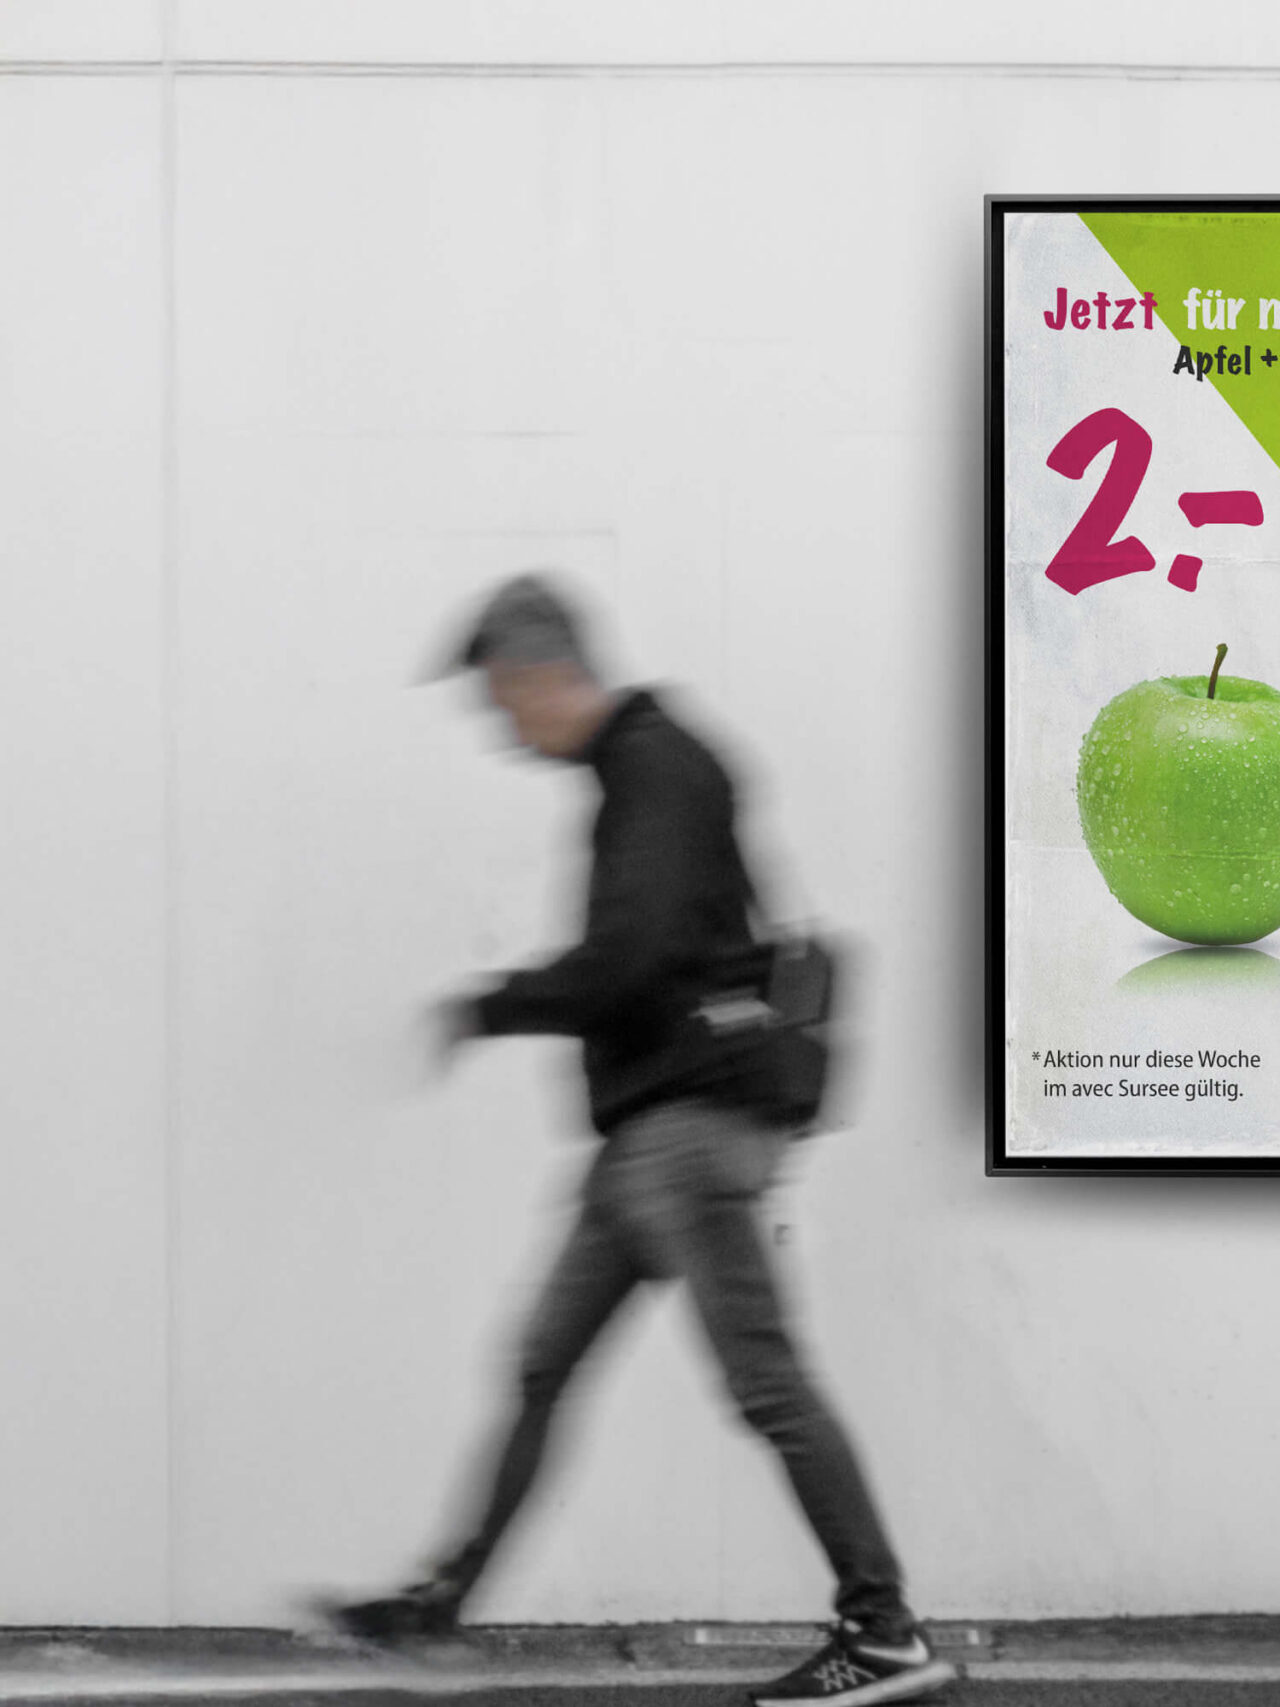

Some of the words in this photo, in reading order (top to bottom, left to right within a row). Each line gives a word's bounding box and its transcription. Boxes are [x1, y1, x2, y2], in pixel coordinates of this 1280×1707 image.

[1043, 287, 1158, 331] Jetzt
[1183, 287, 1246, 331] für
[1172, 344, 1252, 382] Apfel
[1260, 348, 1279, 368] +
[1109, 1054, 1141, 1068] nur
[1145, 1049, 1194, 1068] diese
[1198, 1049, 1261, 1068] Woche
[1044, 1079, 1067, 1097] im
[1072, 1083, 1114, 1097] avec
[1118, 1079, 1180, 1097] Sursee
[1184, 1078, 1245, 1102] gültig.
